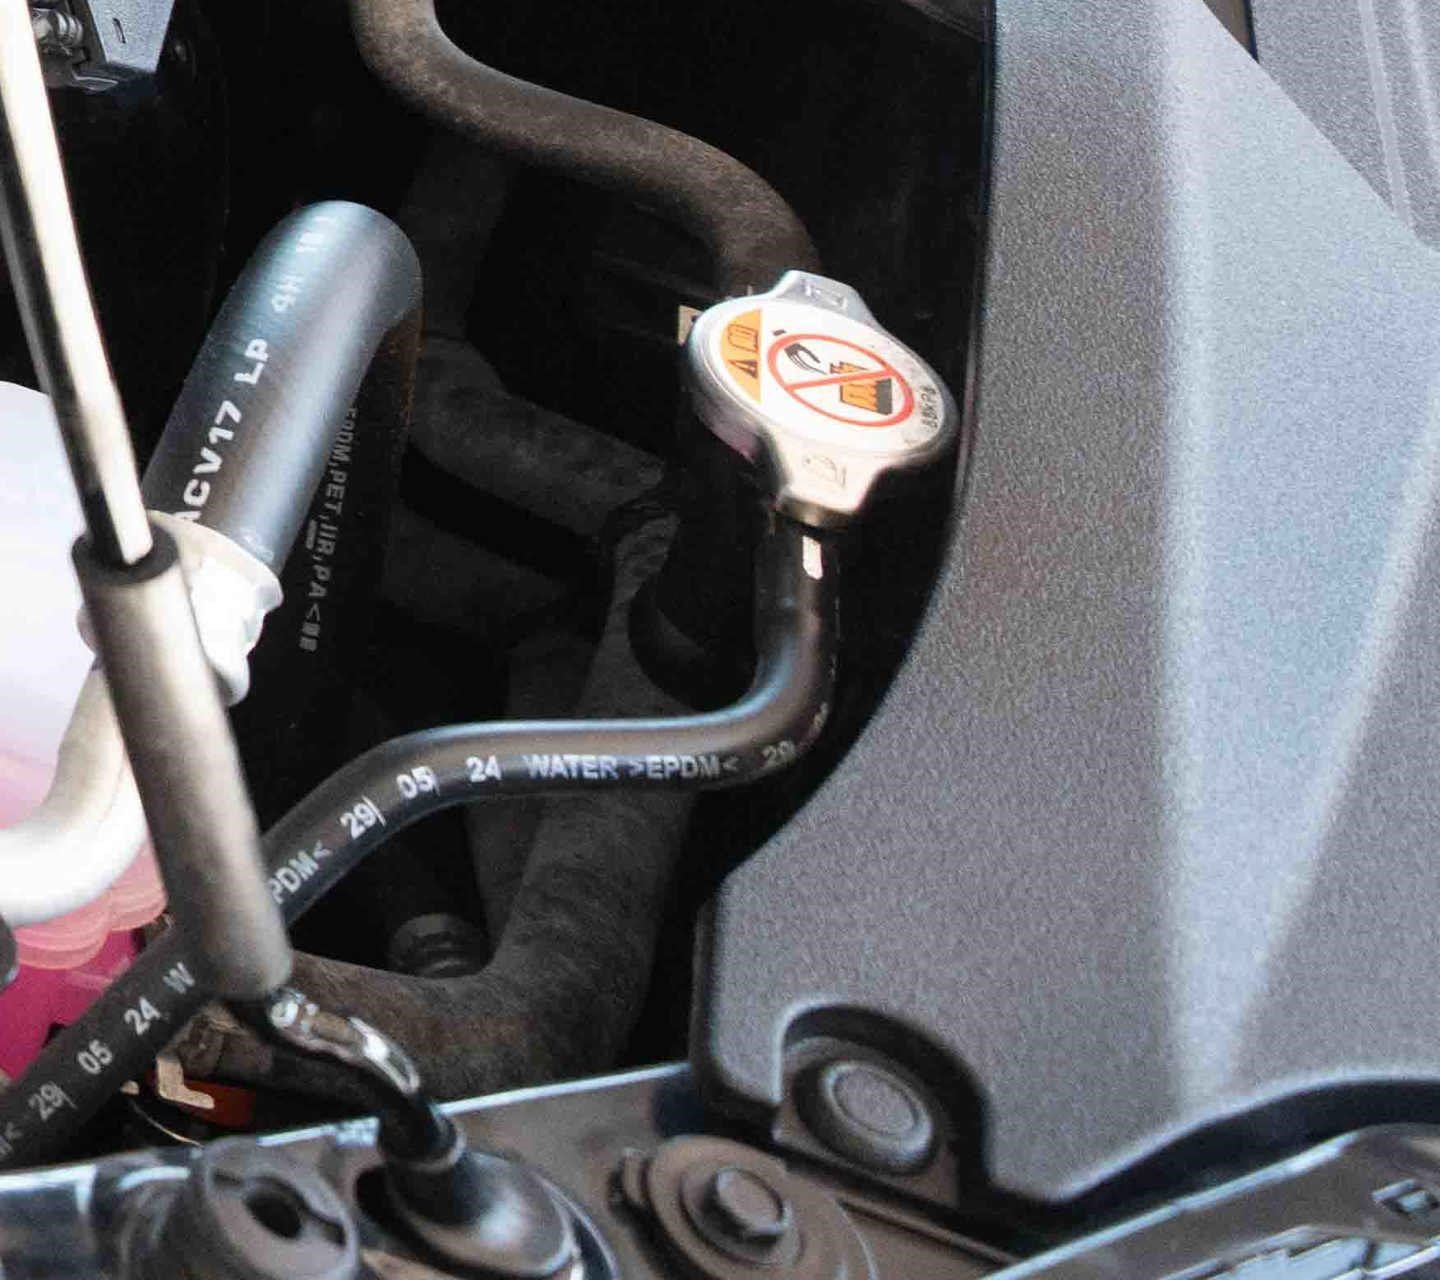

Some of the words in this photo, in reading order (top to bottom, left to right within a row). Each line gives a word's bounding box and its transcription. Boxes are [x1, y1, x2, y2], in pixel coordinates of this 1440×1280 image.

[234, 338, 268, 386] LP
[465, 756, 502, 782] 24
[522, 754, 618, 780] WATER
[76, 1040, 113, 1075] 05
[124, 997, 161, 1035] 24
